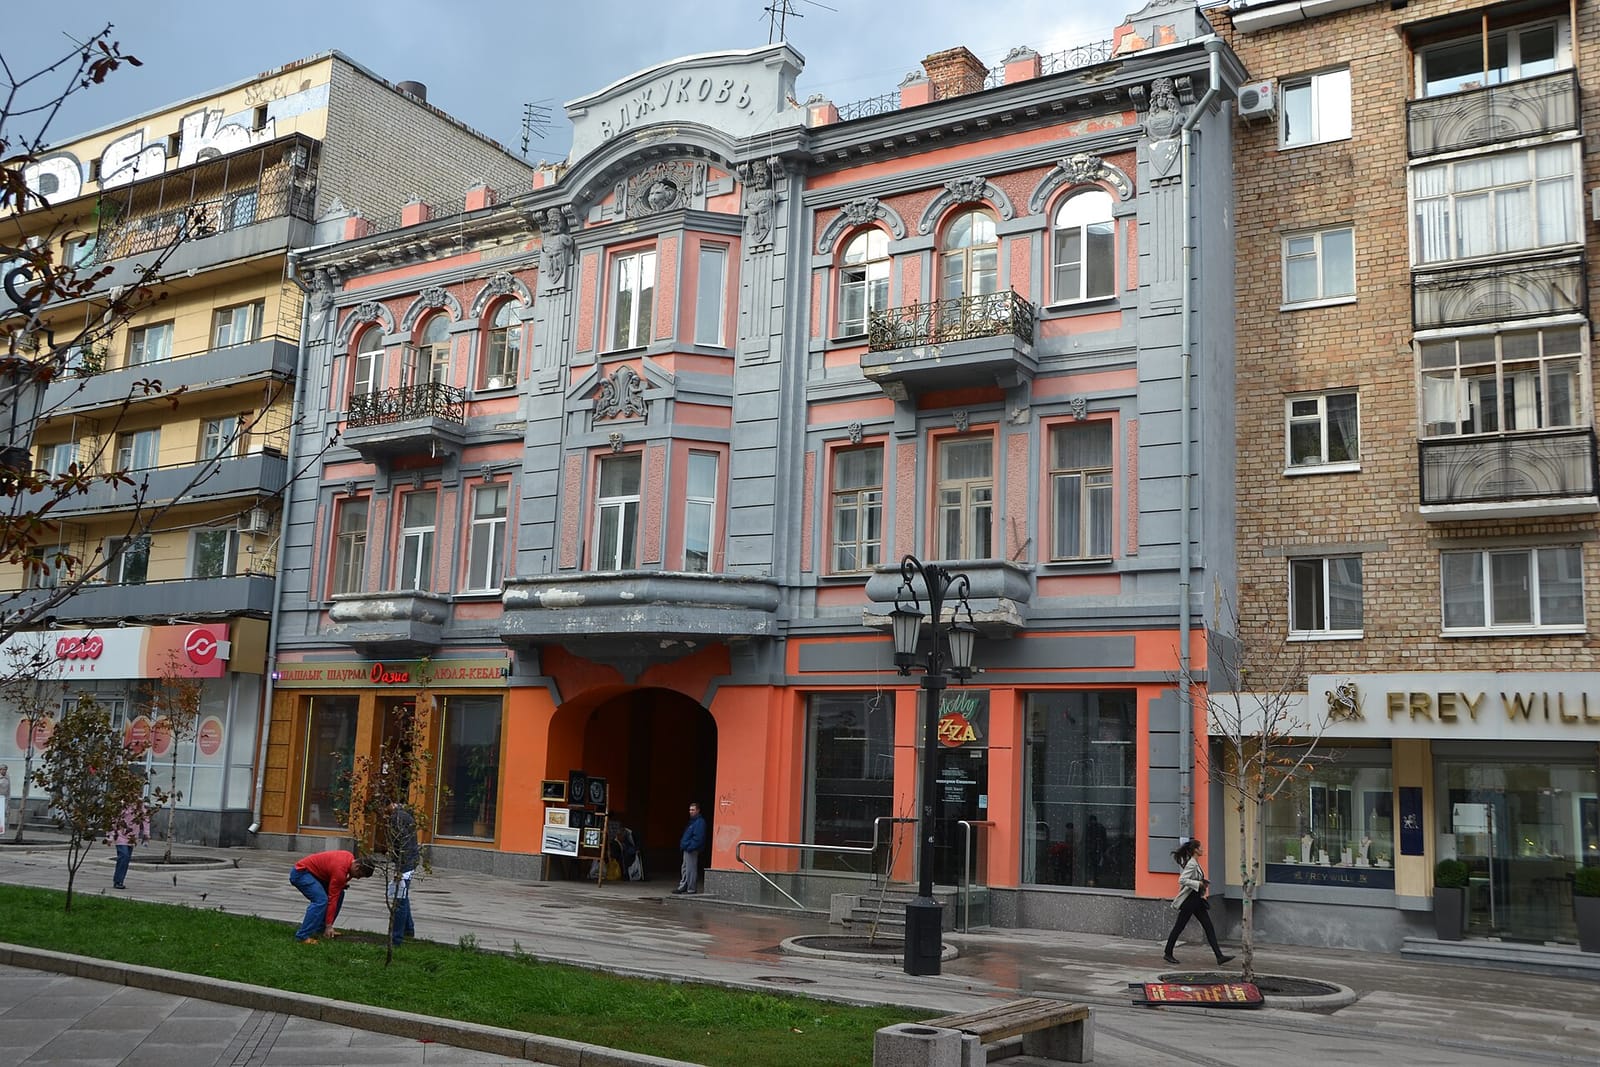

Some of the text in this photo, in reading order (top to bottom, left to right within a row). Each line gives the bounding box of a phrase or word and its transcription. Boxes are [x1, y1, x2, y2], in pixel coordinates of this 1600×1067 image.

[279, 668, 367, 681] ШАШЛЫК ШАУРМА
[369, 662, 410, 684] Оазис
[1386, 691, 1600, 721] FREY WILL
